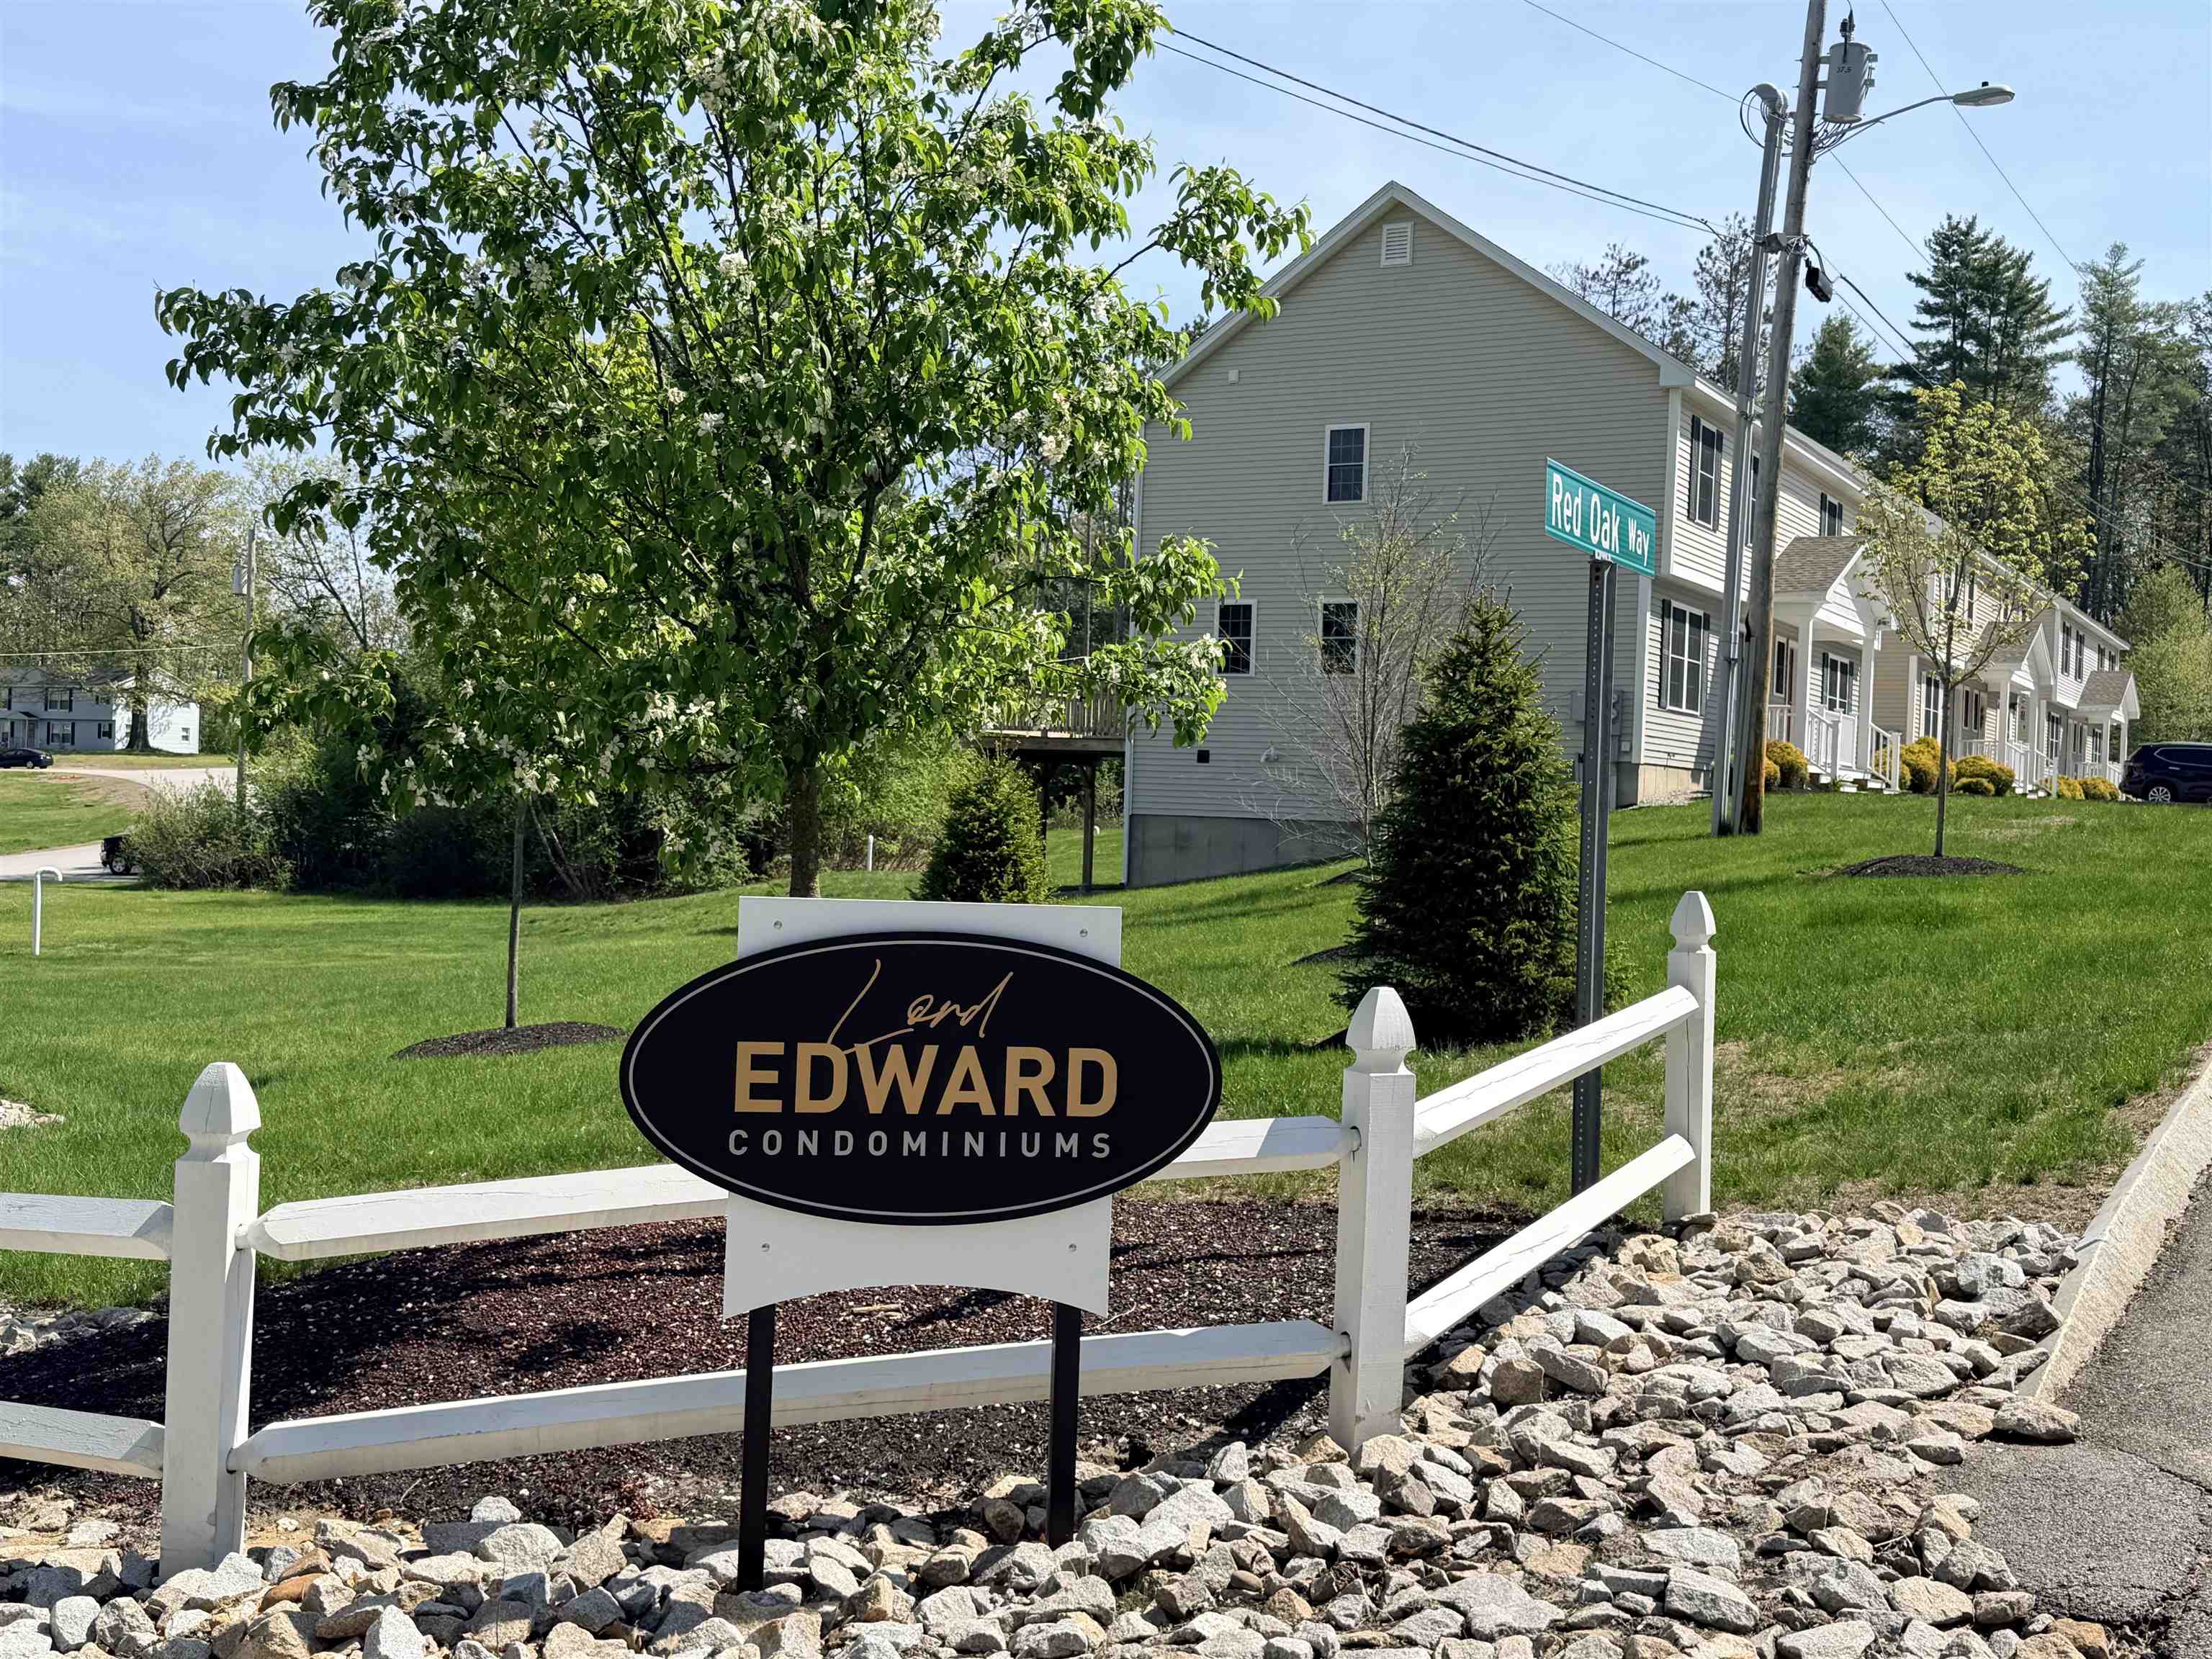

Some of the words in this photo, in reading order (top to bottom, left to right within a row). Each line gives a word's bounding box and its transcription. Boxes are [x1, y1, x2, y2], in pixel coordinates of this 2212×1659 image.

[1552, 472, 1582, 537] Red
[1590, 493, 1620, 554] Oak
[1628, 517, 1650, 567] Way
[827, 958, 1014, 1054] Lord
[734, 1041, 1118, 1118] EDWARD
[729, 1130, 1110, 1159] CONDOMINIUMS
